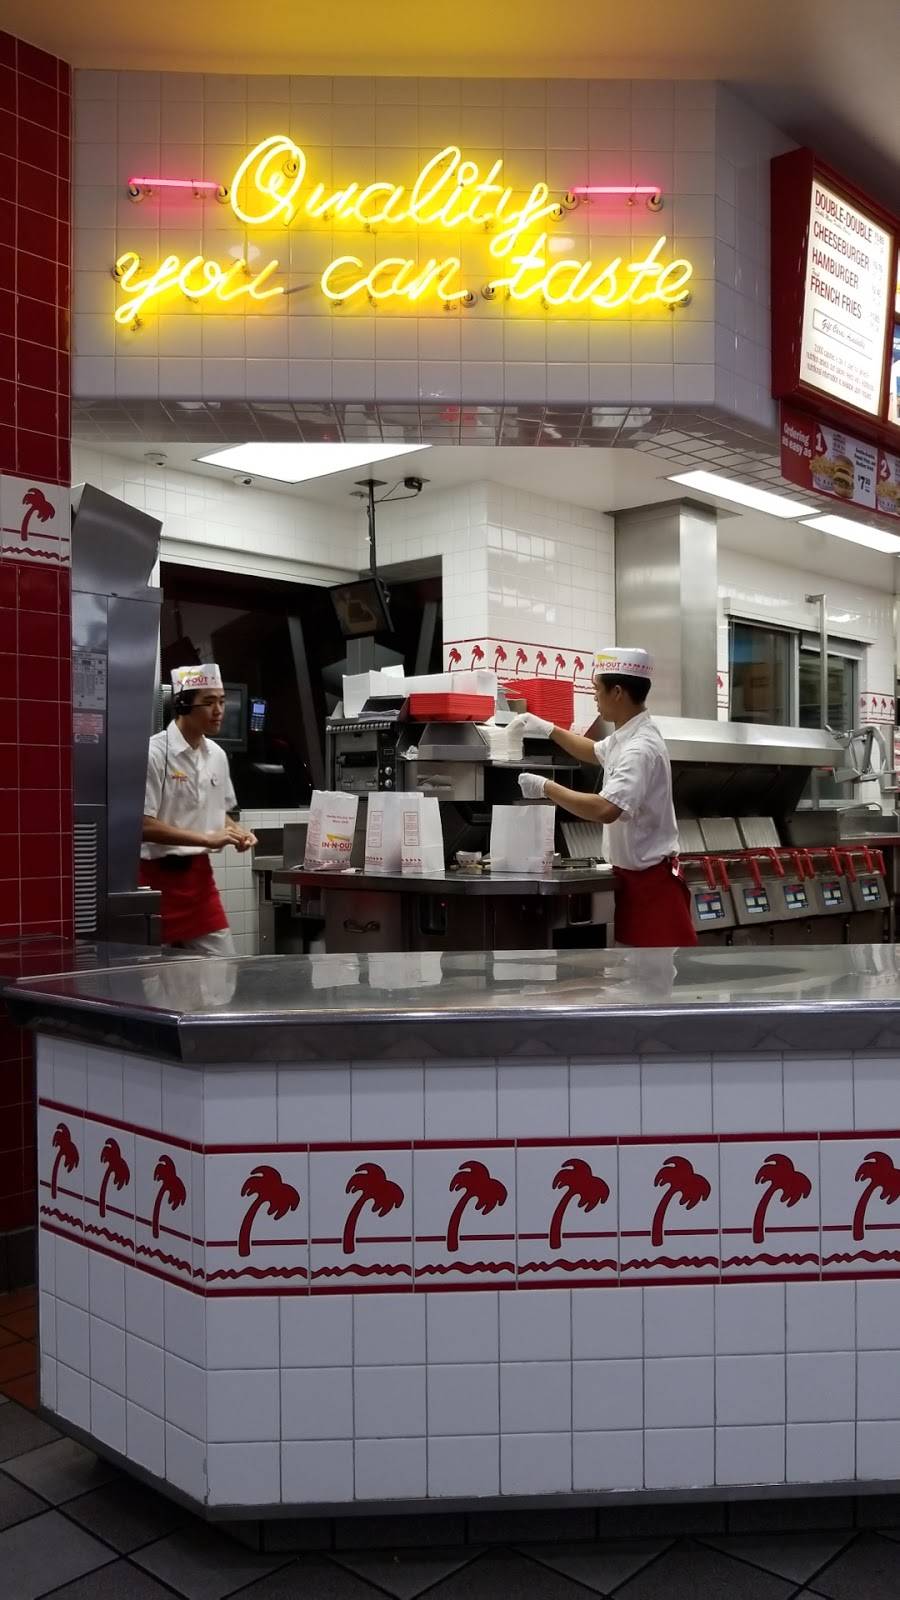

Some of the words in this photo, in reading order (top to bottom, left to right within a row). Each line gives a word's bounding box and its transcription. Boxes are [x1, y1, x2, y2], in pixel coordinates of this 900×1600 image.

[230, 134, 561, 257] Quality
[816, 190, 872, 243] DOUBLE-DOUBLE
[814, 221, 870, 271] CHEESEBURGER
[114, 250, 285, 324] you
[320, 254, 469, 301] can
[489, 233, 695, 308] taste
[812, 248, 859, 289] HAMBURGER
[811, 275, 840, 307] FRENCH
[842, 295, 861, 319] FRIES
[783, 422, 810, 447] Ordering
[789, 440, 803, 456] easy
[803, 447, 812, 458] as
[815, 432, 824, 452] 1
[880, 459, 888, 478] 2
